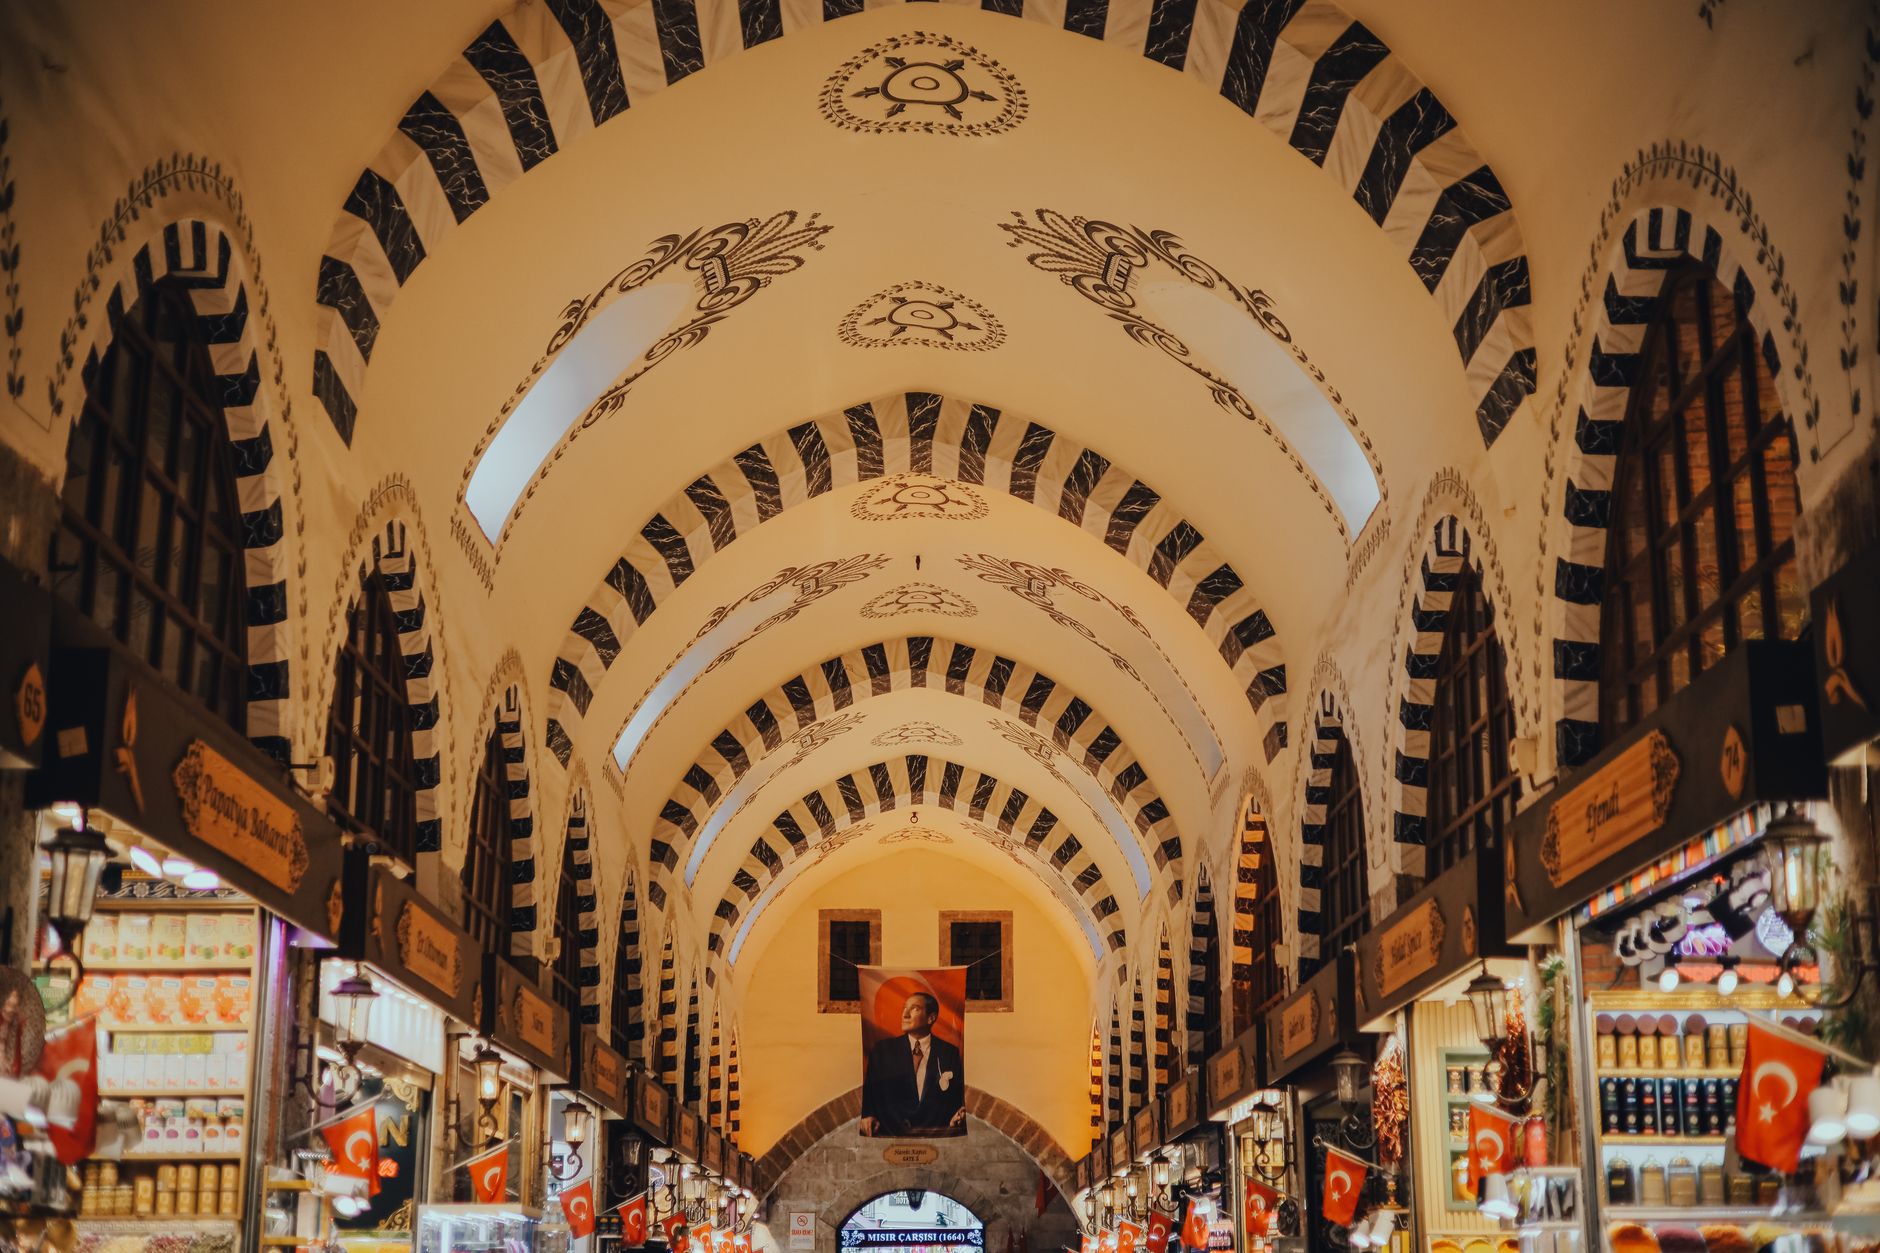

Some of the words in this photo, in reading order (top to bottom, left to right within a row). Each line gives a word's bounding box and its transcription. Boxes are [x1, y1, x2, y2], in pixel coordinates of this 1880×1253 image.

[1725, 741, 1740, 783] 74
[203, 773, 248, 838] Papatya
[249, 806, 290, 859] Baharat
[1586, 780, 1620, 843] Efendi
[867, 1233, 897, 1242] MISIR
[898, 1233, 937, 1244] ÇARŞISI
[938, 1232, 966, 1243] (1664)
